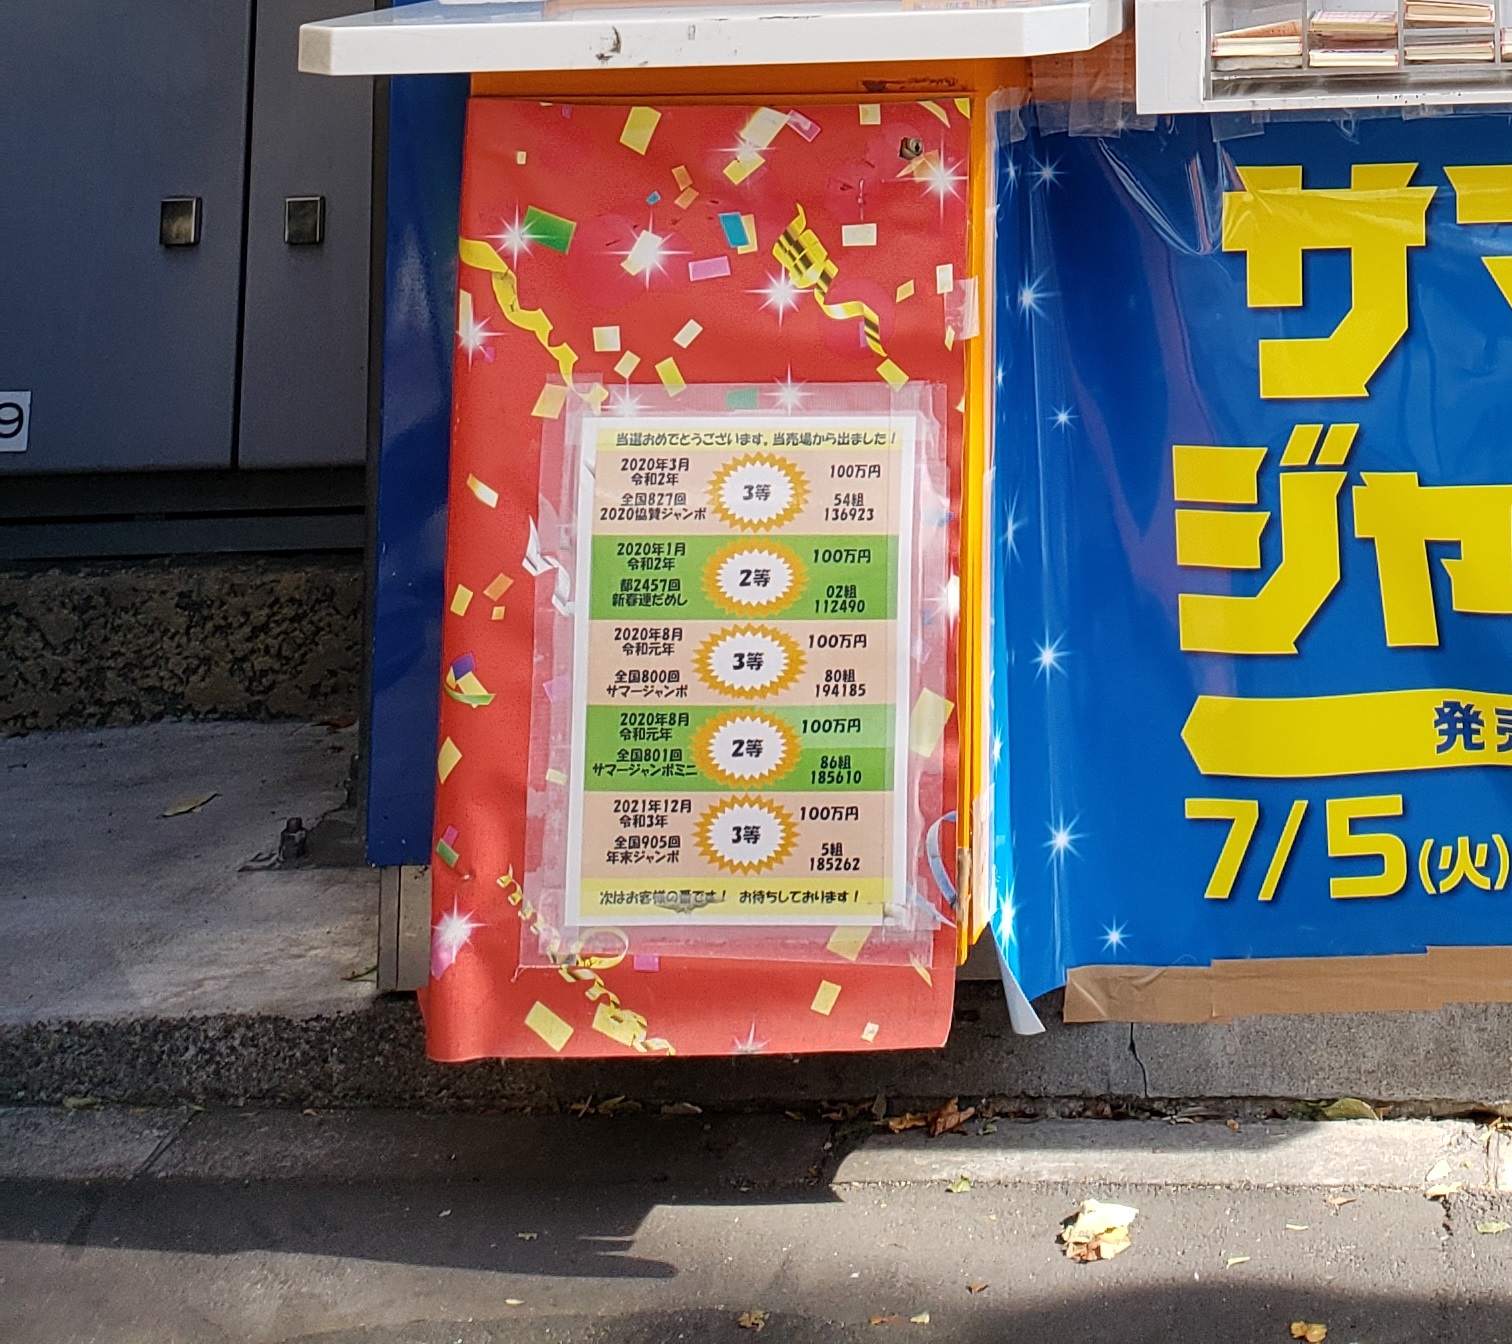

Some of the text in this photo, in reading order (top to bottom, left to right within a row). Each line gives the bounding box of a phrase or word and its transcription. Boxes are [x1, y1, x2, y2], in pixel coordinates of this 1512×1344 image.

[621, 457, 690, 472] 2020年3月
[829, 464, 882, 479] 100万円
[631, 473, 679, 486] 令和2年
[621, 493, 687, 507] 全国827回
[742, 484, 771, 501] 3等
[833, 493, 865, 507] 54組
[824, 507, 875, 522] 136923
[617, 542, 686, 557] 2020年1月
[813, 548, 872, 564] 100万円
[620, 578, 681, 593] 都2457回
[739, 568, 772, 588] 2等
[826, 584, 858, 599] 02組
[612, 593, 688, 608] 新春運だめし
[814, 599, 866, 614] 112490
[622, 642, 676, 657] 令和元年
[808, 634, 868, 650] 100万円
[614, 669, 680, 684] 全国800回
[824, 669, 856, 683] 80組
[606, 684, 689, 699] サマージャンボ
[815, 683, 867, 698] 194185
[616, 748, 683, 763] 全国801回
[731, 739, 764, 758] 2等
[820, 754, 852, 770] 86組
[592, 763, 698, 778] サマージャンボミニ
[810, 770, 862, 785] 185610
[613, 799, 692, 814] 2021年12月
[799, 806, 859, 822] 100万円
[619, 814, 668, 829] 令和3年
[731, 825, 761, 844] 3等
[614, 835, 681, 850] 全国905回
[821, 843, 844, 857] 5組
[606, 850, 680, 865] 年末ジャンボ
[810, 857, 861, 872] 185262
